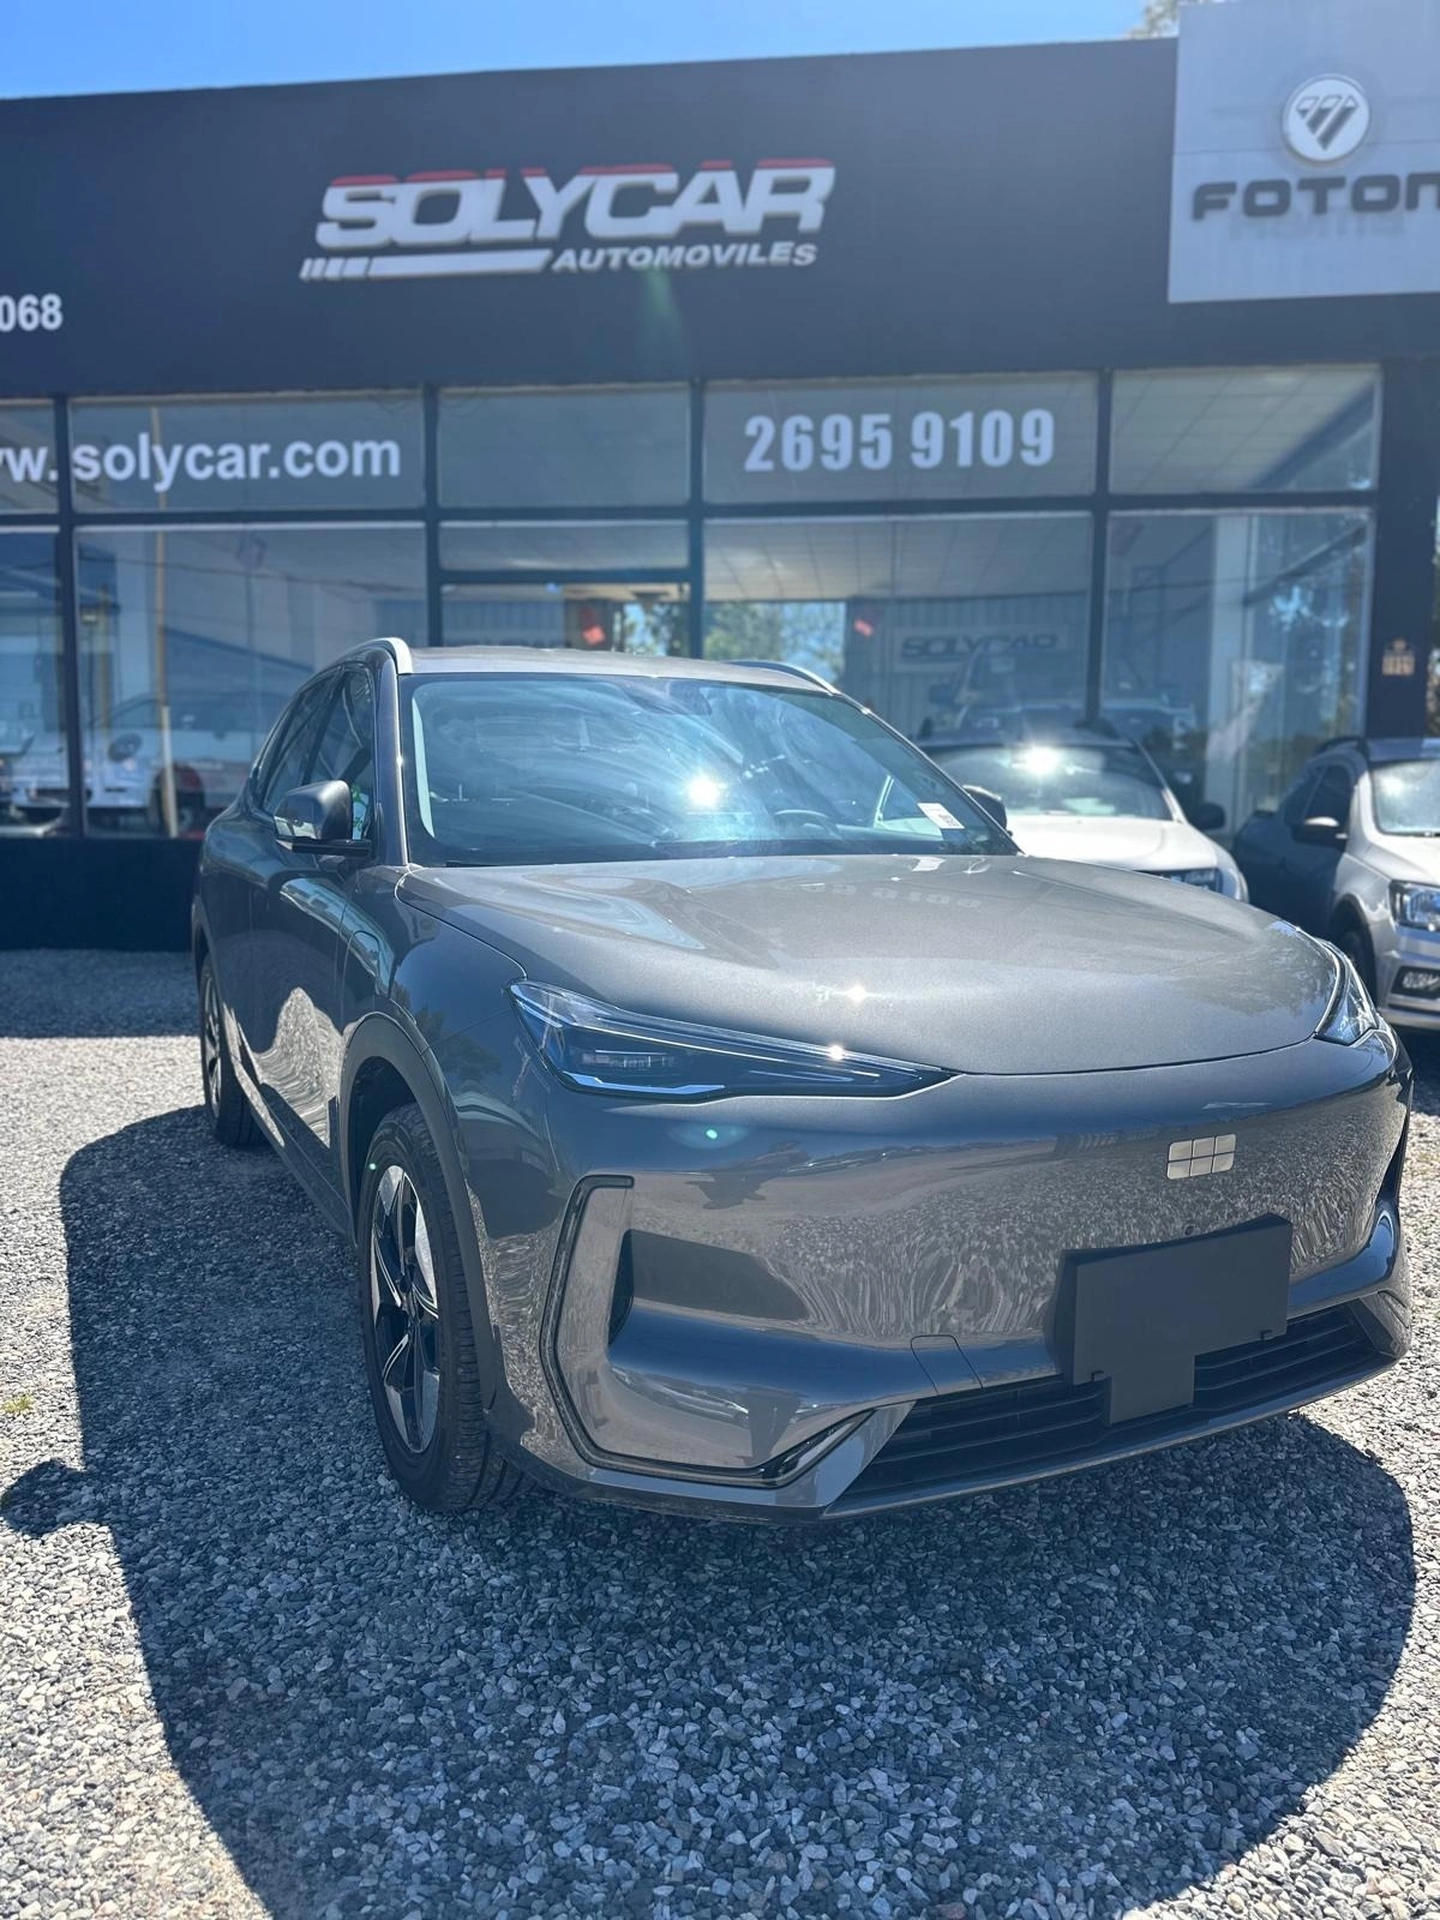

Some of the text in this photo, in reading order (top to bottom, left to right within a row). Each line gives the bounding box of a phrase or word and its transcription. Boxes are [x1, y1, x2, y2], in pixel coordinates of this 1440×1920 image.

[315, 157, 836, 249] SOLYCAR
[551, 241, 818, 272] AUTOMOVILES
[0, 293, 63, 331] 068
[743, 408, 1055, 472] 2695 9109
